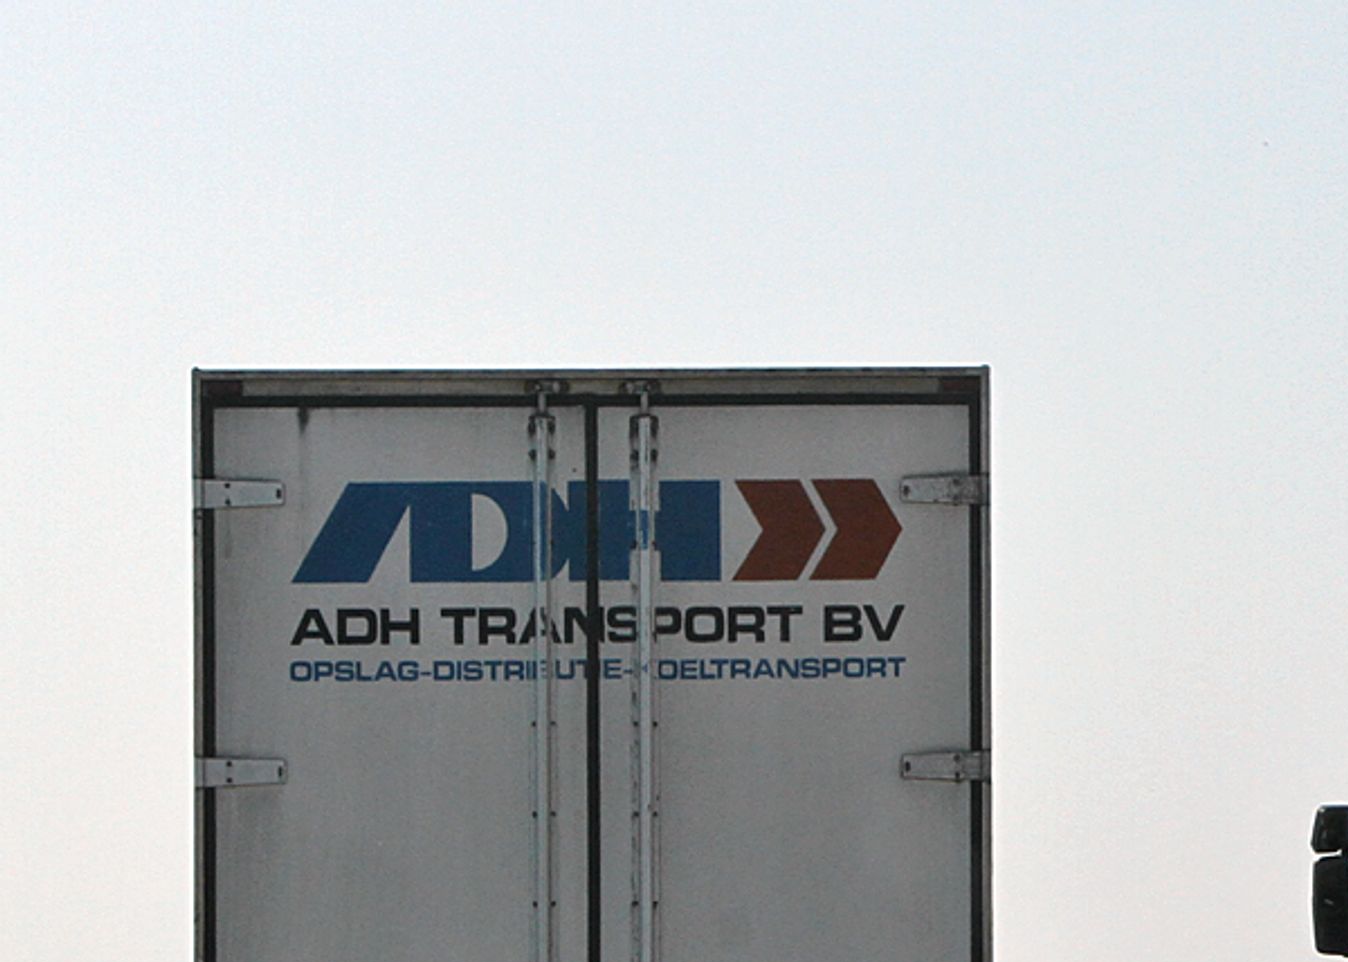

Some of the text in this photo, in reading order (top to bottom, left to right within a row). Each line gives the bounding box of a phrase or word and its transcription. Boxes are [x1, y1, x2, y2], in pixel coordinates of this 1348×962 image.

[292, 479, 721, 583] ADH
[290, 604, 905, 646] ADH TRANSPORT BV
